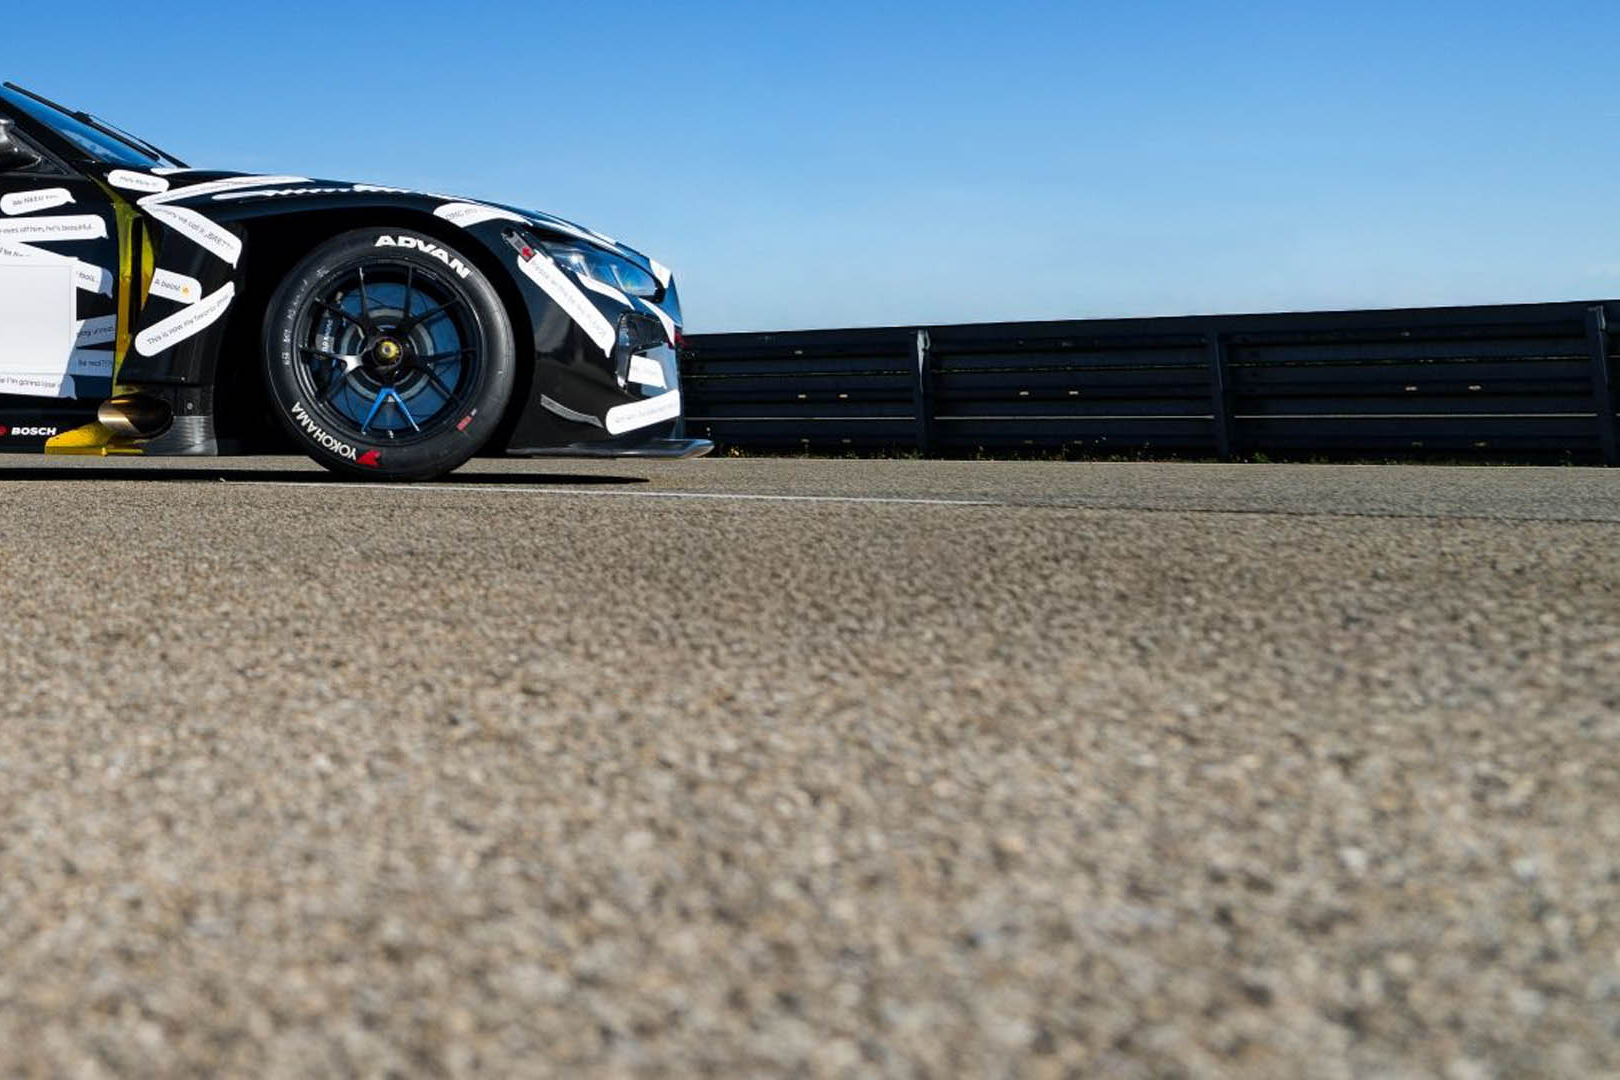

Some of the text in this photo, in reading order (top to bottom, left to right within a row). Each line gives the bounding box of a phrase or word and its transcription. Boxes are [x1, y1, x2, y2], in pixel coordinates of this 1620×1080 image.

[374, 235, 472, 279] ADVAN
[11, 426, 57, 436] BOSCH
[291, 401, 357, 461] YOKOHAMA
